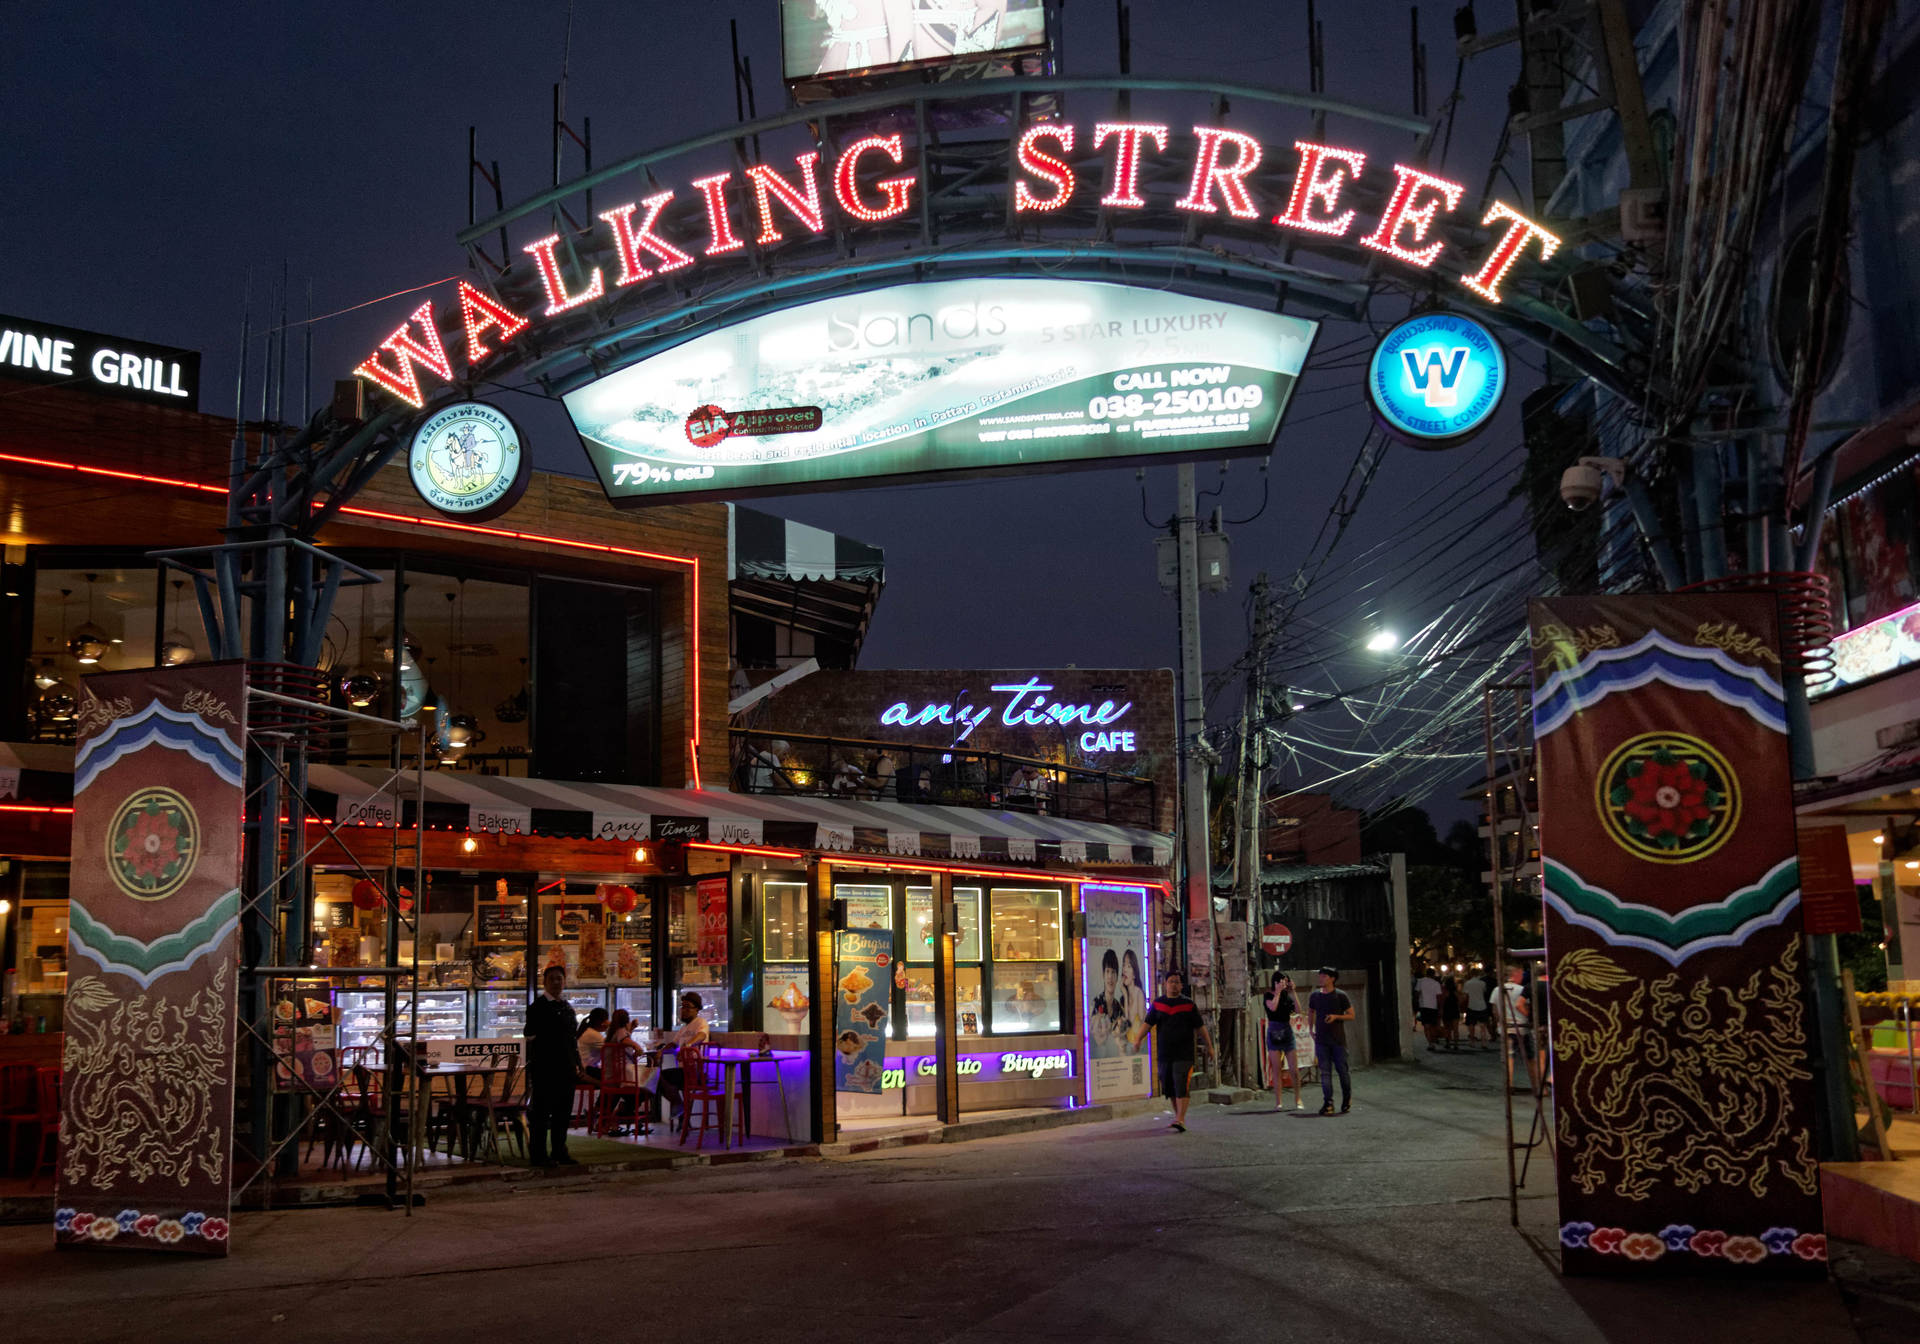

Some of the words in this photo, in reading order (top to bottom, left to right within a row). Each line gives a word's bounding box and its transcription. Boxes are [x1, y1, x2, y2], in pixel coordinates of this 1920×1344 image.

[353, 135, 916, 408] WALKING
[1014, 122, 1562, 304] STREET
[1063, 321, 1122, 342] STAR
[1133, 311, 1228, 336] LUXURY
[92, 349, 189, 397] GRILL
[1113, 371, 1167, 391] CALL
[1170, 366, 1231, 387] NOW
[1088, 385, 1263, 419] 038-250109
[1377, 371, 1404, 419] WALKING
[1407, 416, 1447, 431] STREET
[1453, 366, 1499, 426] COMMUNITY
[689, 414, 730, 440] EIA
[734, 410, 816, 428] Approved
[767, 445, 790, 459] and
[863, 421, 911, 445] location
[914, 416, 928, 429] in
[931, 400, 977, 425] Pattaya
[612, 463, 671, 486] 79%
[673, 466, 715, 482] SOLD
[881, 701, 992, 763] any
[1080, 731, 1136, 752] CAFE
[349, 803, 392, 821] Coffee
[478, 813, 521, 831] Bakery
[601, 820, 644, 837] any
[657, 819, 700, 836] time
[722, 824, 750, 839] Wine
[843, 933, 891, 955] Bingsu
[456, 1045, 481, 1056] CAFE
[482, 1045, 490, 1055] &
[492, 1044, 519, 1054] GRILL
[1001, 1053, 1069, 1078] Bingsu
